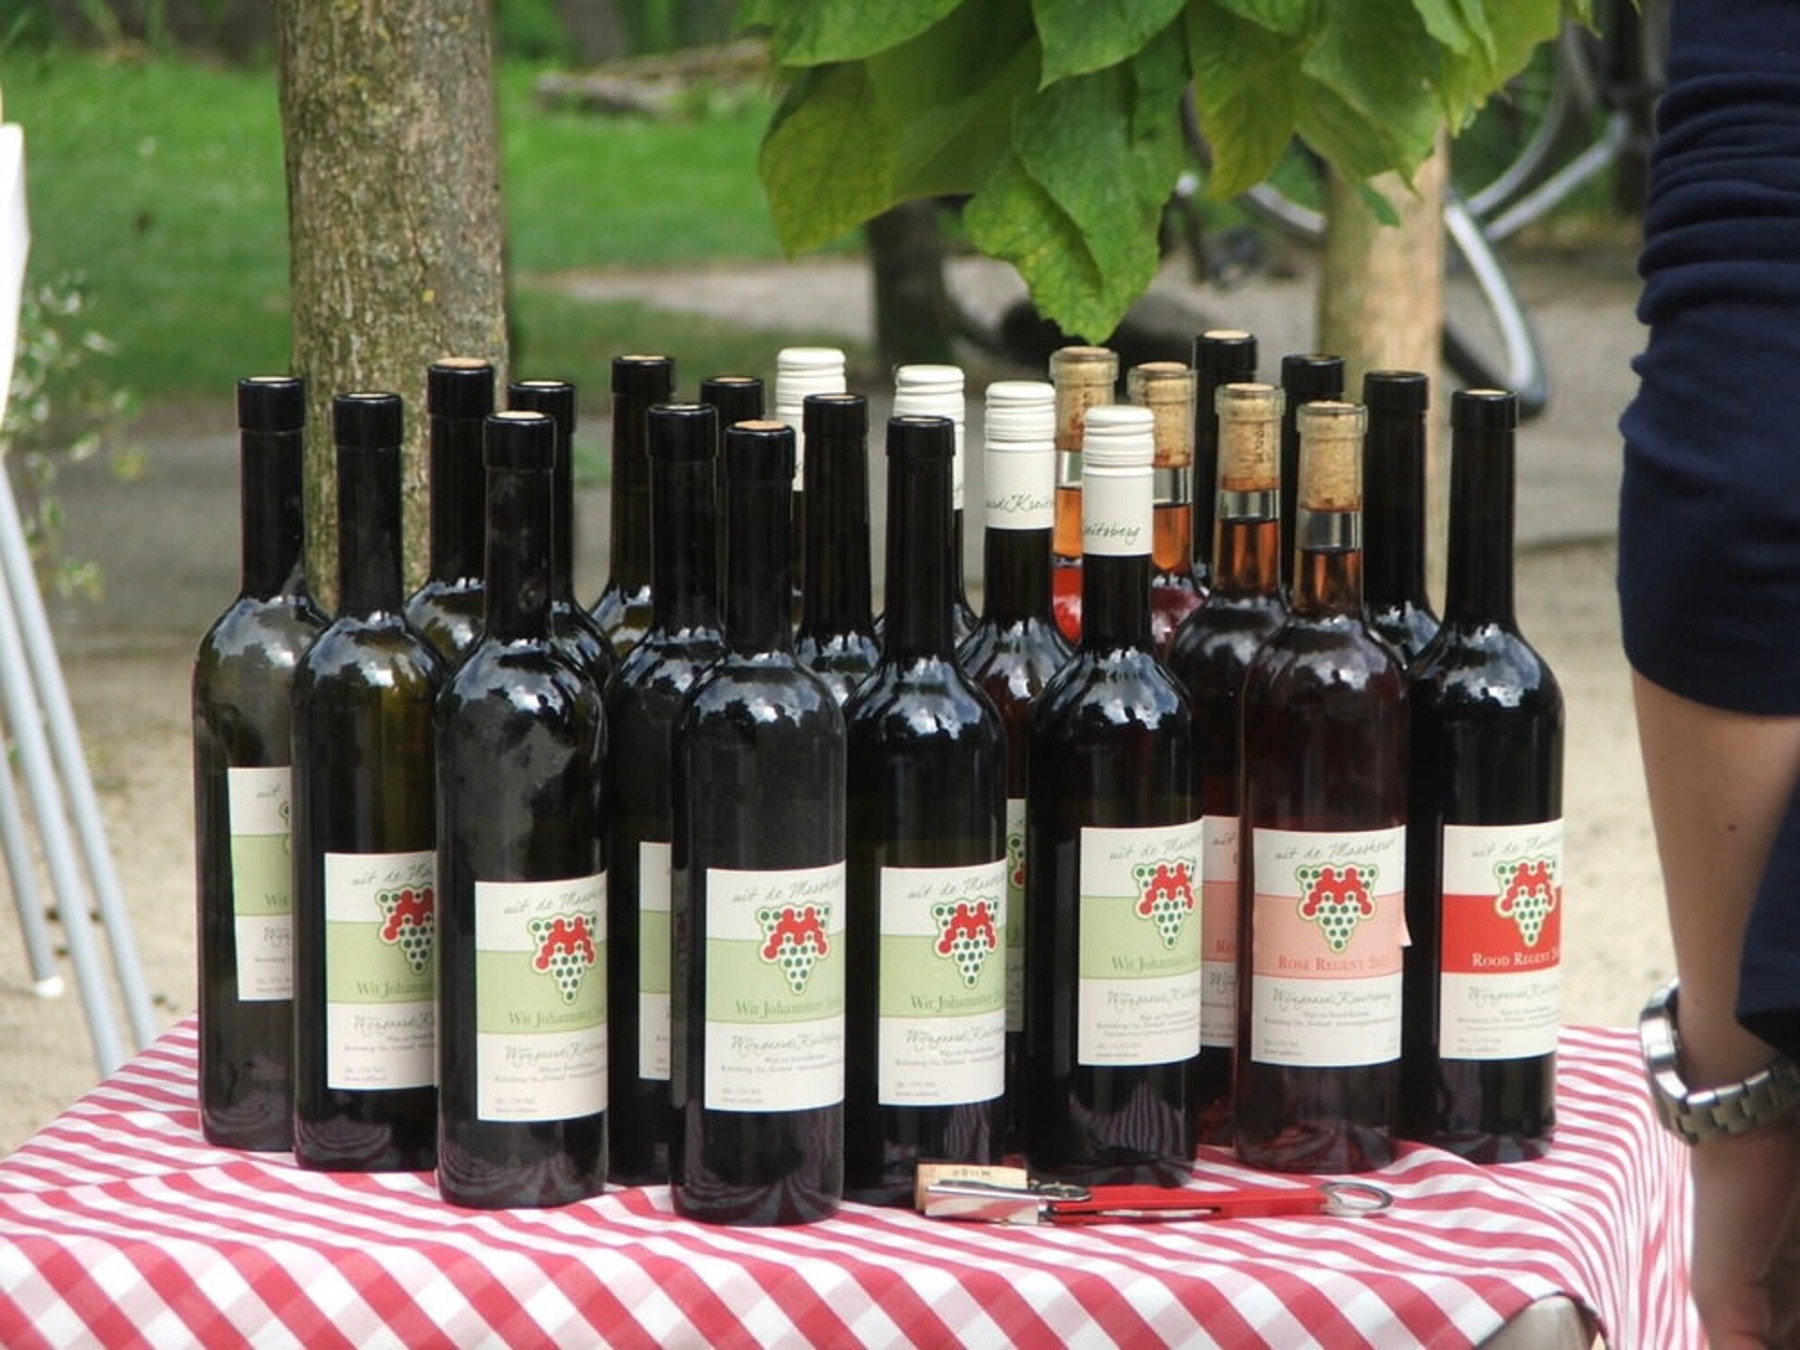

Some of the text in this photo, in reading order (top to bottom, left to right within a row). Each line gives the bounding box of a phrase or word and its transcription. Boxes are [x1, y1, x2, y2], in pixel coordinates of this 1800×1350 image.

[1109, 842, 1136, 860] uit
[1140, 843, 1158, 857] de
[1274, 845, 1298, 860] uit
[1303, 846, 1322, 860] de
[1470, 841, 1497, 858] uit
[1500, 842, 1520, 856] de
[732, 886, 759, 902] uit
[765, 886, 783, 901] de
[907, 882, 934, 899] uit
[939, 881, 957, 895] de
[503, 897, 530, 914] uit
[535, 896, 553, 911] de
[1112, 955, 1135, 971] Wit
[1315, 956, 1364, 972] REGENT
[1471, 951, 1511, 968] ROOD
[1513, 947, 1550, 966] REGENT
[356, 980, 380, 995] Wit
[735, 1000, 760, 1015] Wit
[910, 994, 935, 1009] Wit
[508, 1010, 532, 1025] Wit
